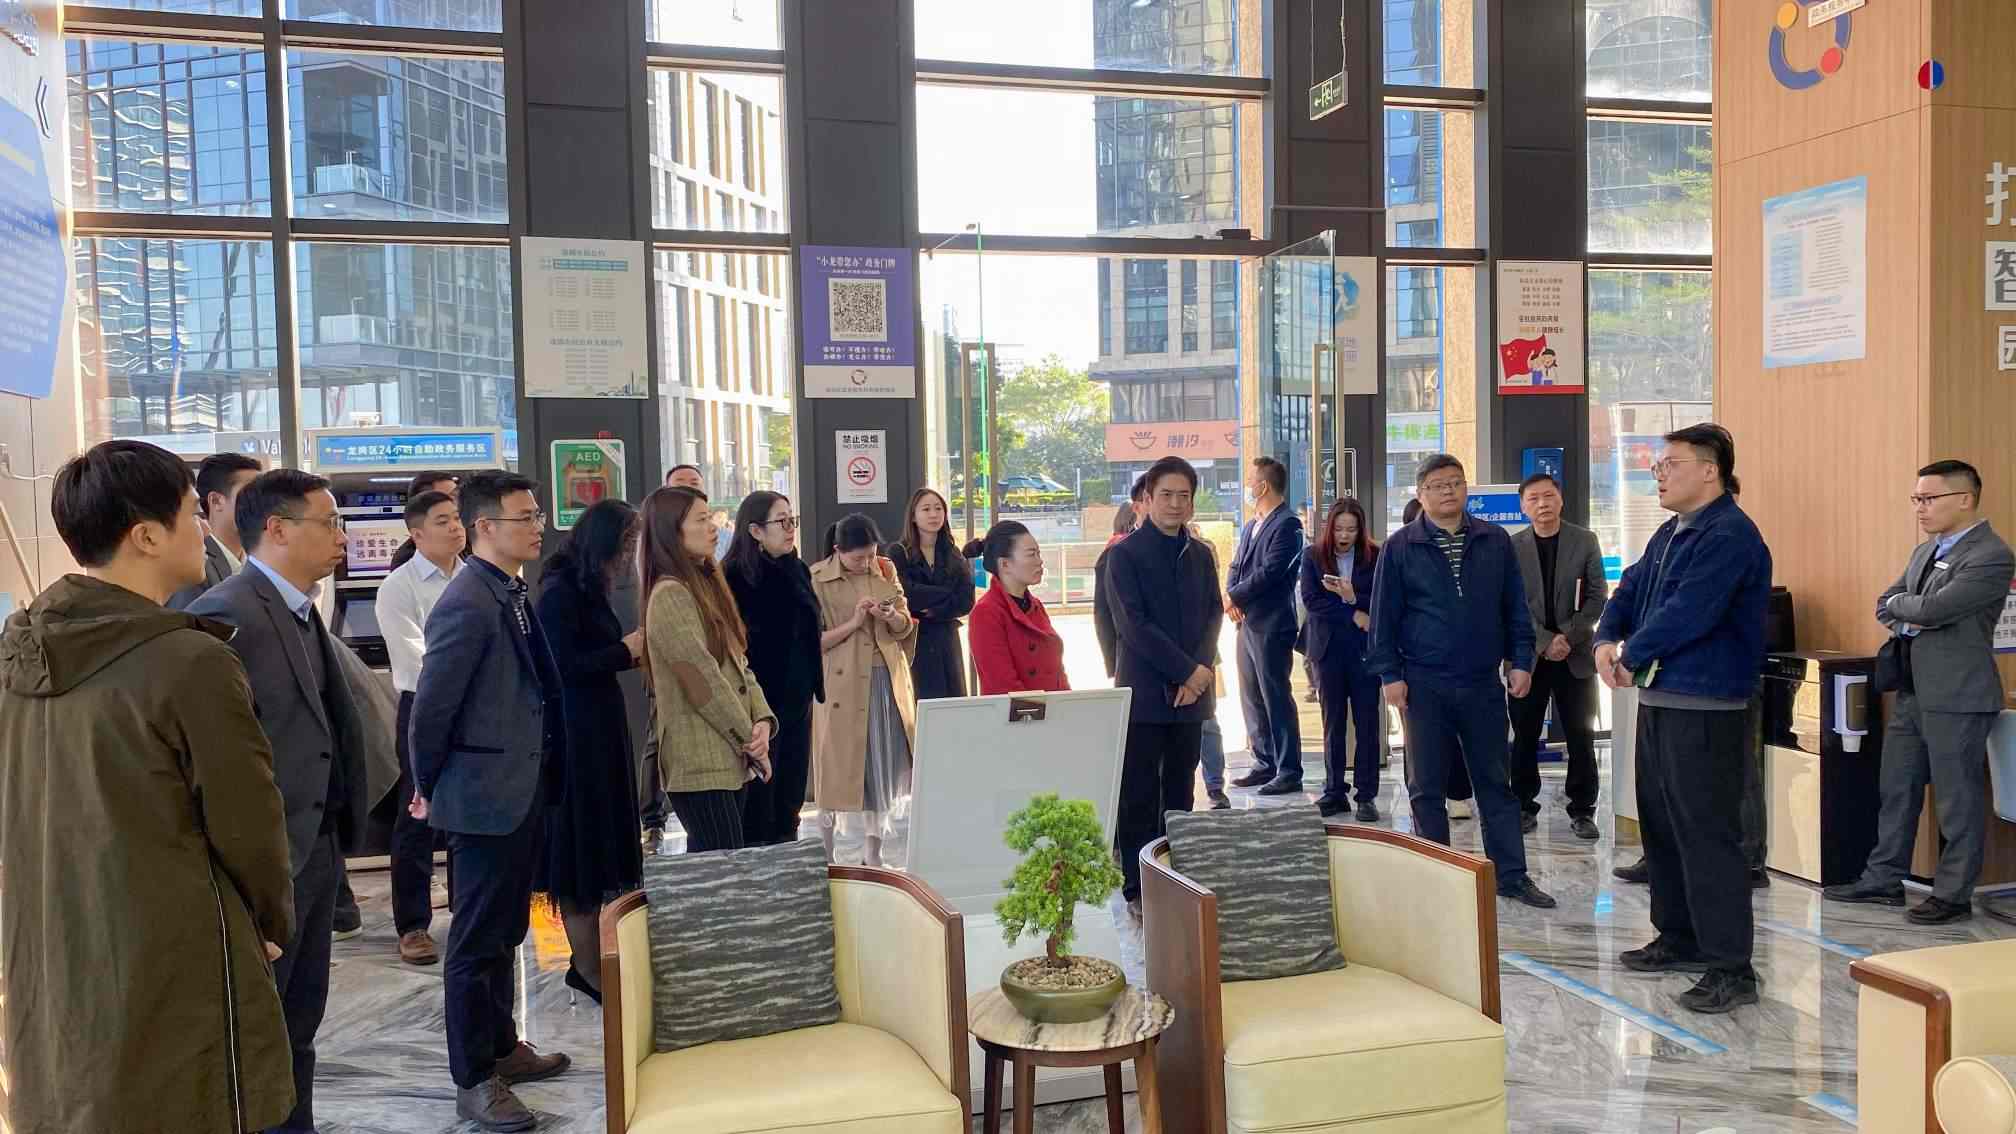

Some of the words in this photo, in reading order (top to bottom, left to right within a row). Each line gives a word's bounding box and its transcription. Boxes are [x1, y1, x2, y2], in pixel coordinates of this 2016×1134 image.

[842, 434, 879, 443] 禁止吸烟
[576, 451, 601, 461] AED
